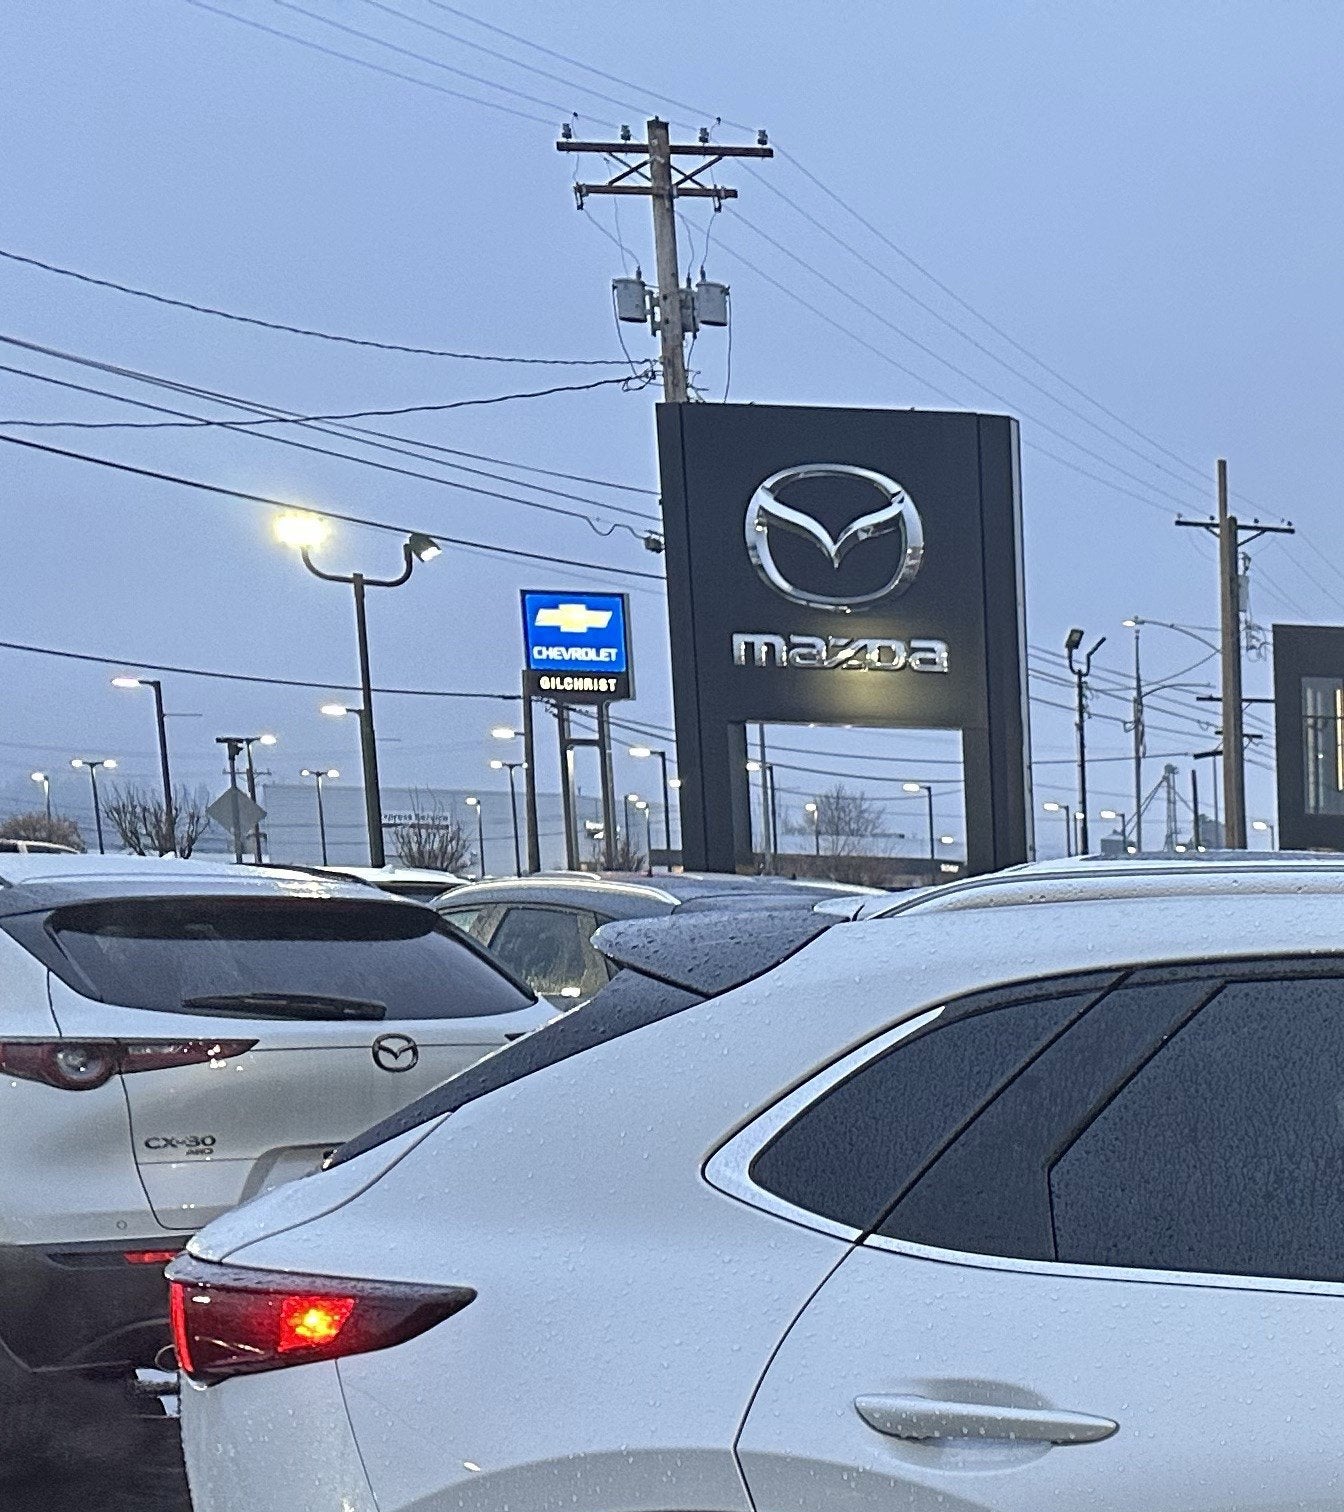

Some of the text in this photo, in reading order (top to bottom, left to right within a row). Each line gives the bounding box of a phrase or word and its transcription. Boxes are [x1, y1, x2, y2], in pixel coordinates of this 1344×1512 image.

[532, 646, 618, 661] CHEVROLET
[732, 632, 949, 673] mazda
[539, 676, 617, 692] GILCHRIST
[144, 1135, 216, 1149] CX-30
